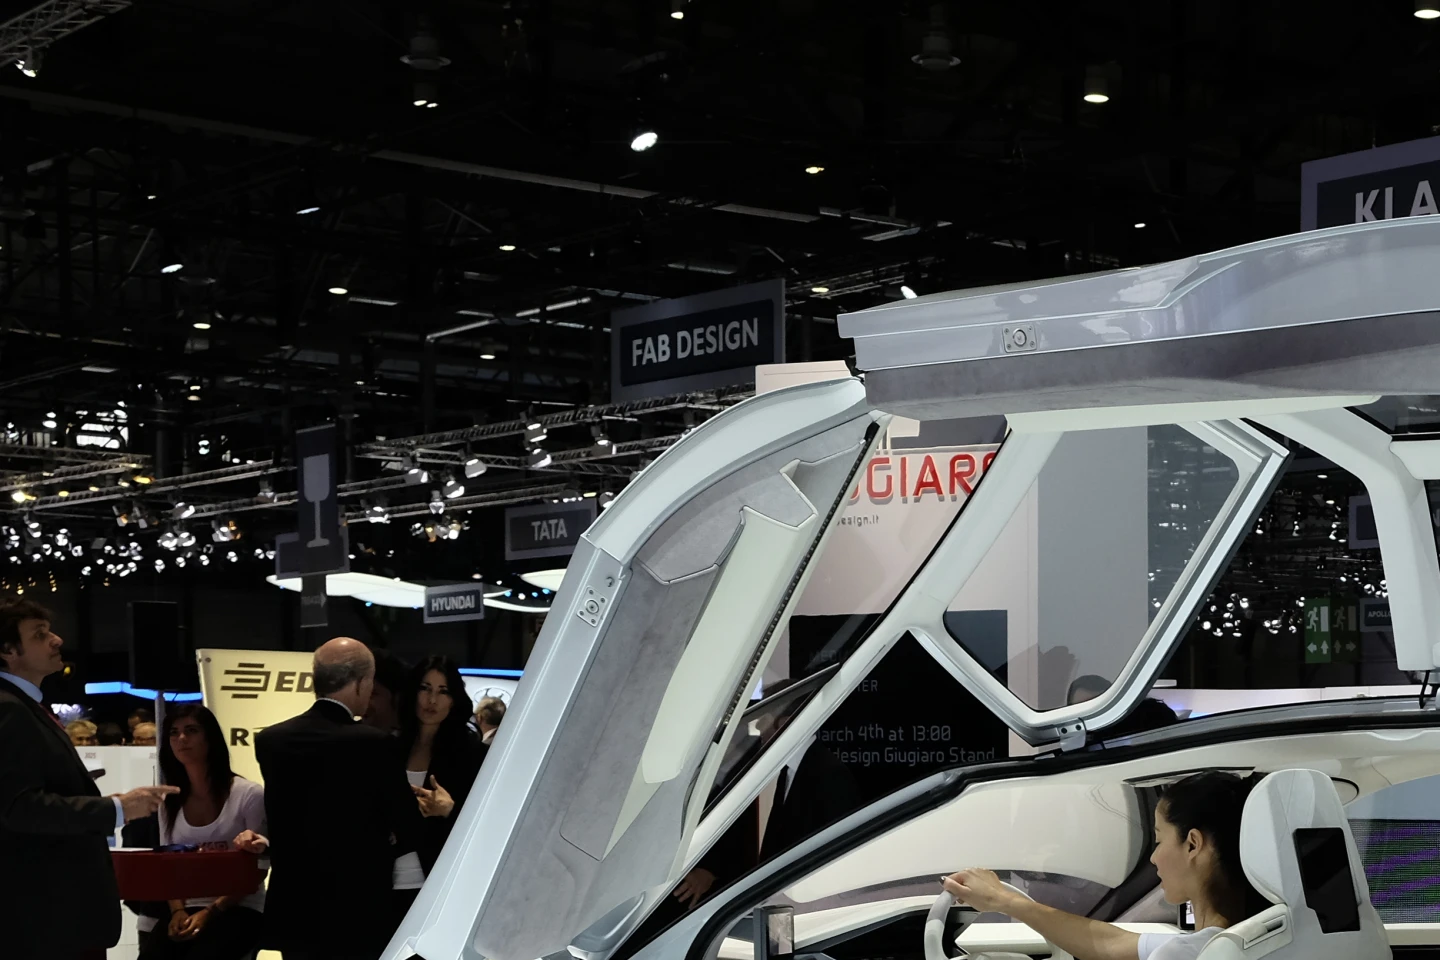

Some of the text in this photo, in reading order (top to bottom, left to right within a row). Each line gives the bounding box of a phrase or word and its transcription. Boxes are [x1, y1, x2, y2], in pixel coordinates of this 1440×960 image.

[630, 317, 760, 368] FAB DESIGN
[531, 519, 568, 542] TATA
[431, 593, 476, 612] HYUNDAI
[857, 723, 885, 742] 4th
[888, 725, 905, 742] at
[912, 725, 952, 742] 13:00
[884, 746, 945, 767] Giugiaro
[949, 746, 995, 763] Stand
